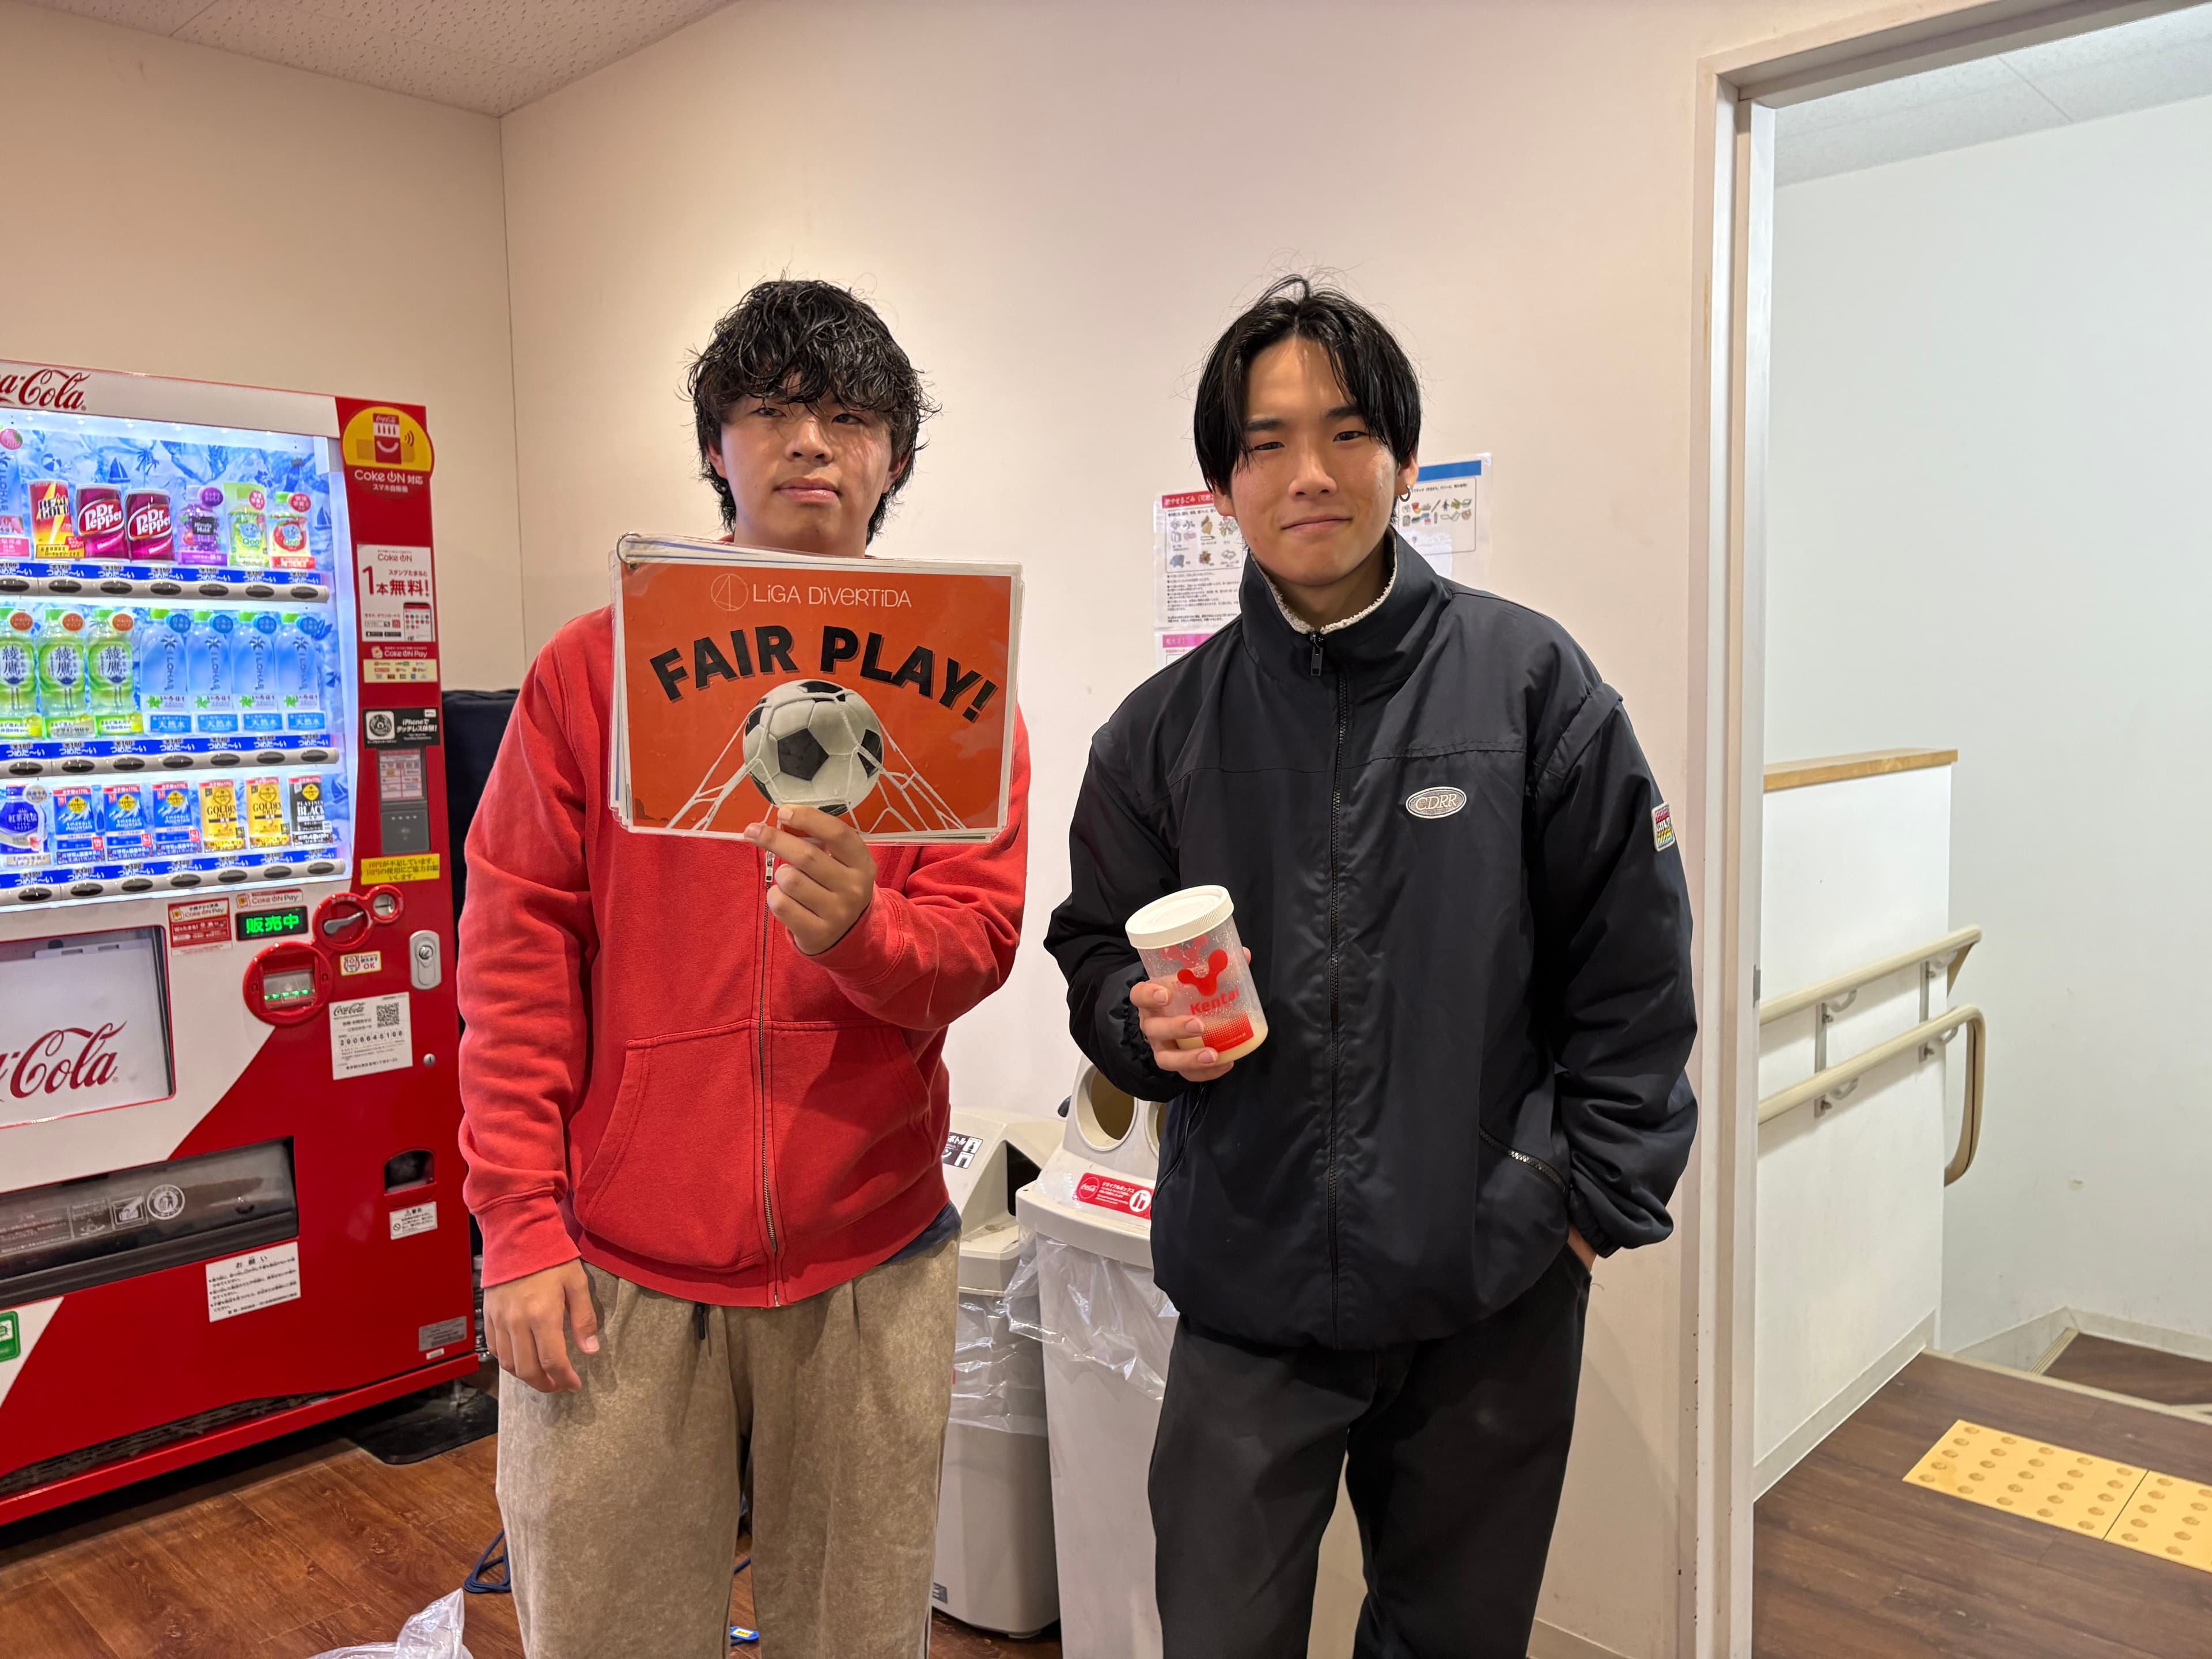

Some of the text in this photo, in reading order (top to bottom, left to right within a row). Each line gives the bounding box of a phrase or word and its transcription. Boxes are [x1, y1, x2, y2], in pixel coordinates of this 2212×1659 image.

[355, 469, 385, 480] Coke
[387, 471, 405, 483] ON
[39, 494, 67, 507] REAL
[40, 505, 69, 518] GOLD
[96, 504, 113, 518] Dr
[147, 509, 164, 521] Dr
[414, 650, 427, 659] Pay
[650, 626, 998, 723] FAIR PLAY!
[1415, 793, 1457, 810] CDRR
[246, 914, 299, 934] 販売中
